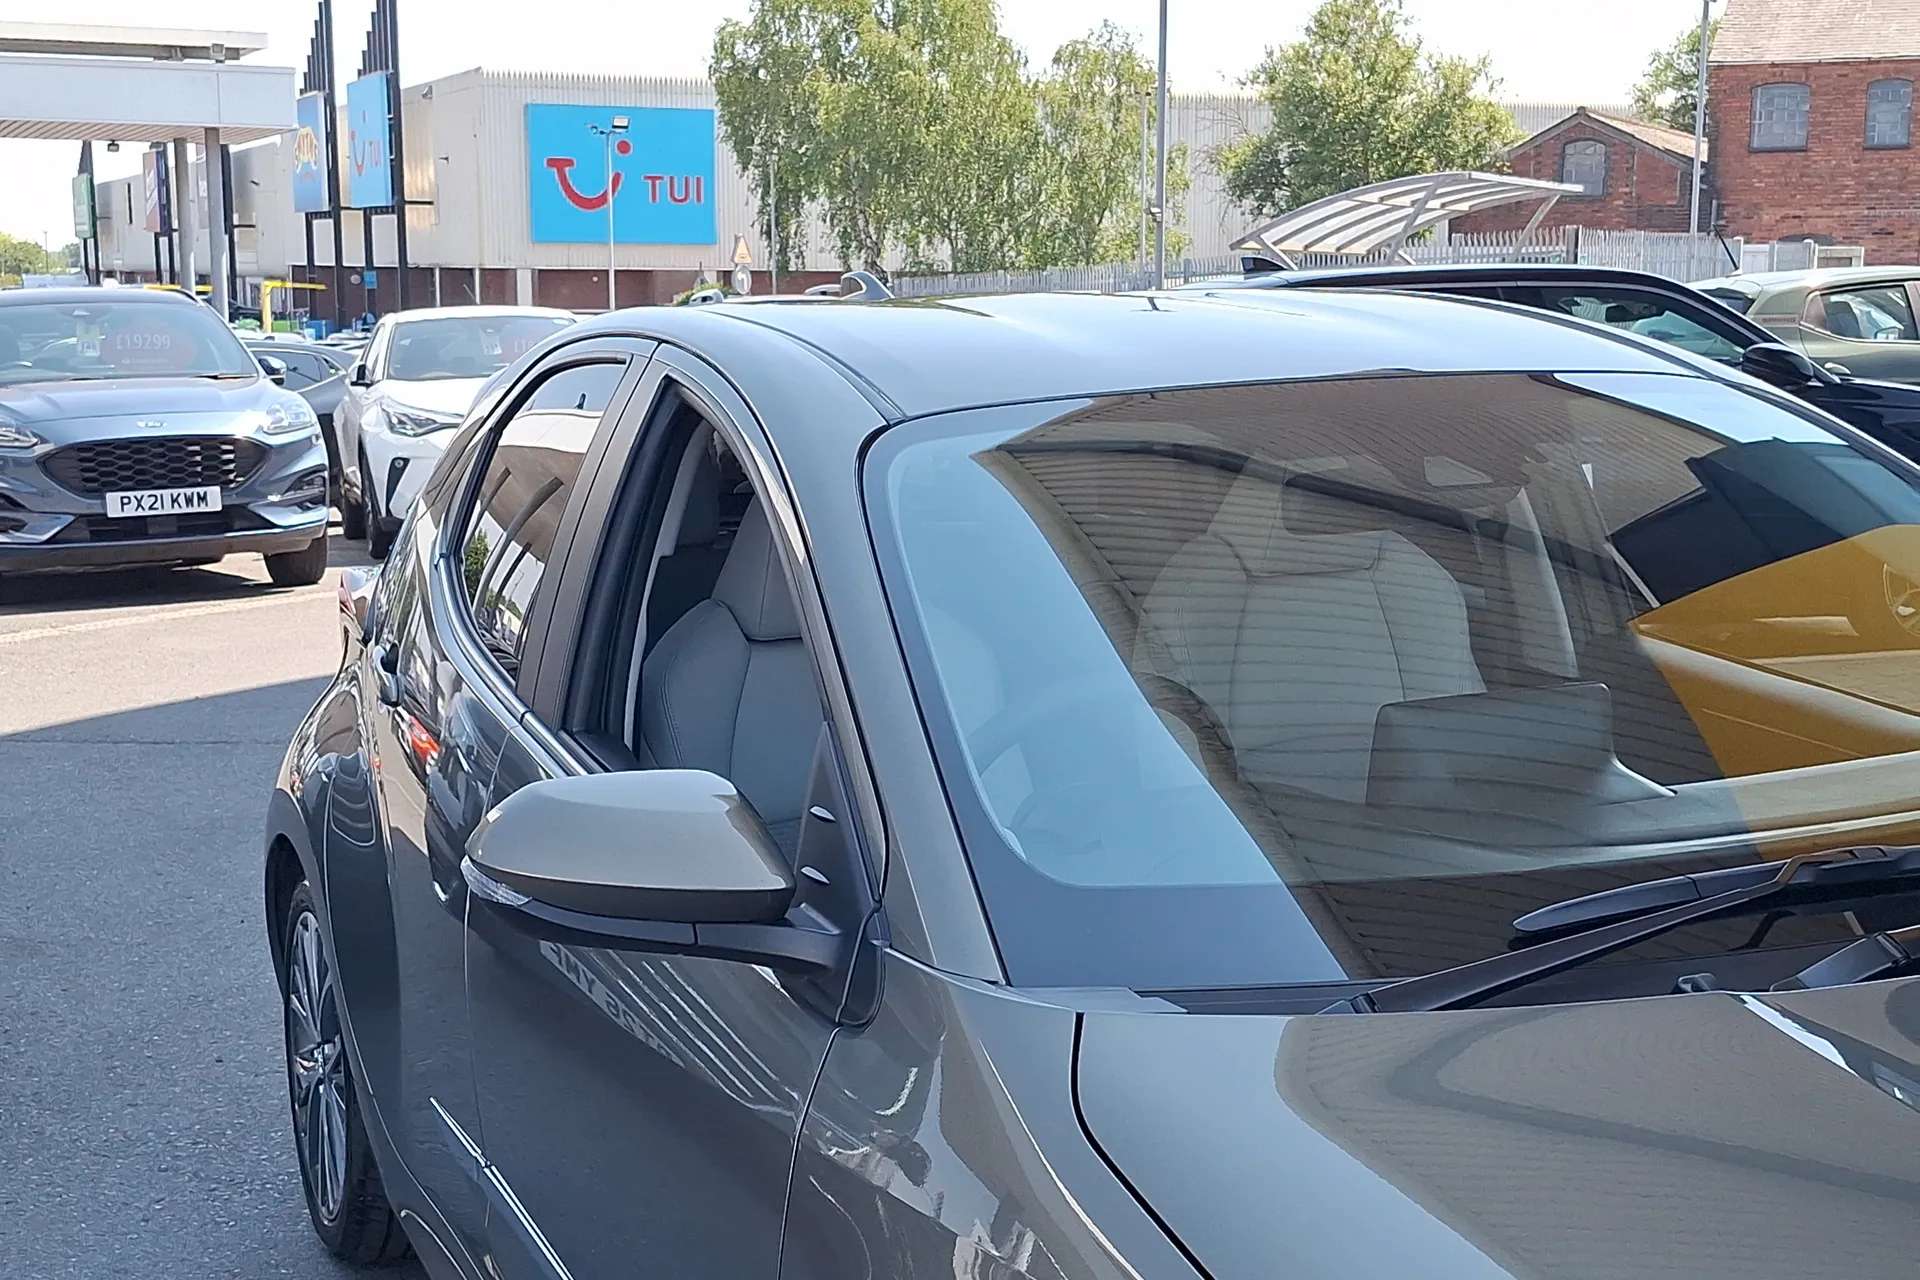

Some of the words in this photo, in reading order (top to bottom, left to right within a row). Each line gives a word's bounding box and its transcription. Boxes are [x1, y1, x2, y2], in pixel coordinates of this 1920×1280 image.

[643, 175, 703, 204] TUI
[120, 494, 164, 512] PX21
[170, 490, 208, 510] KWM
